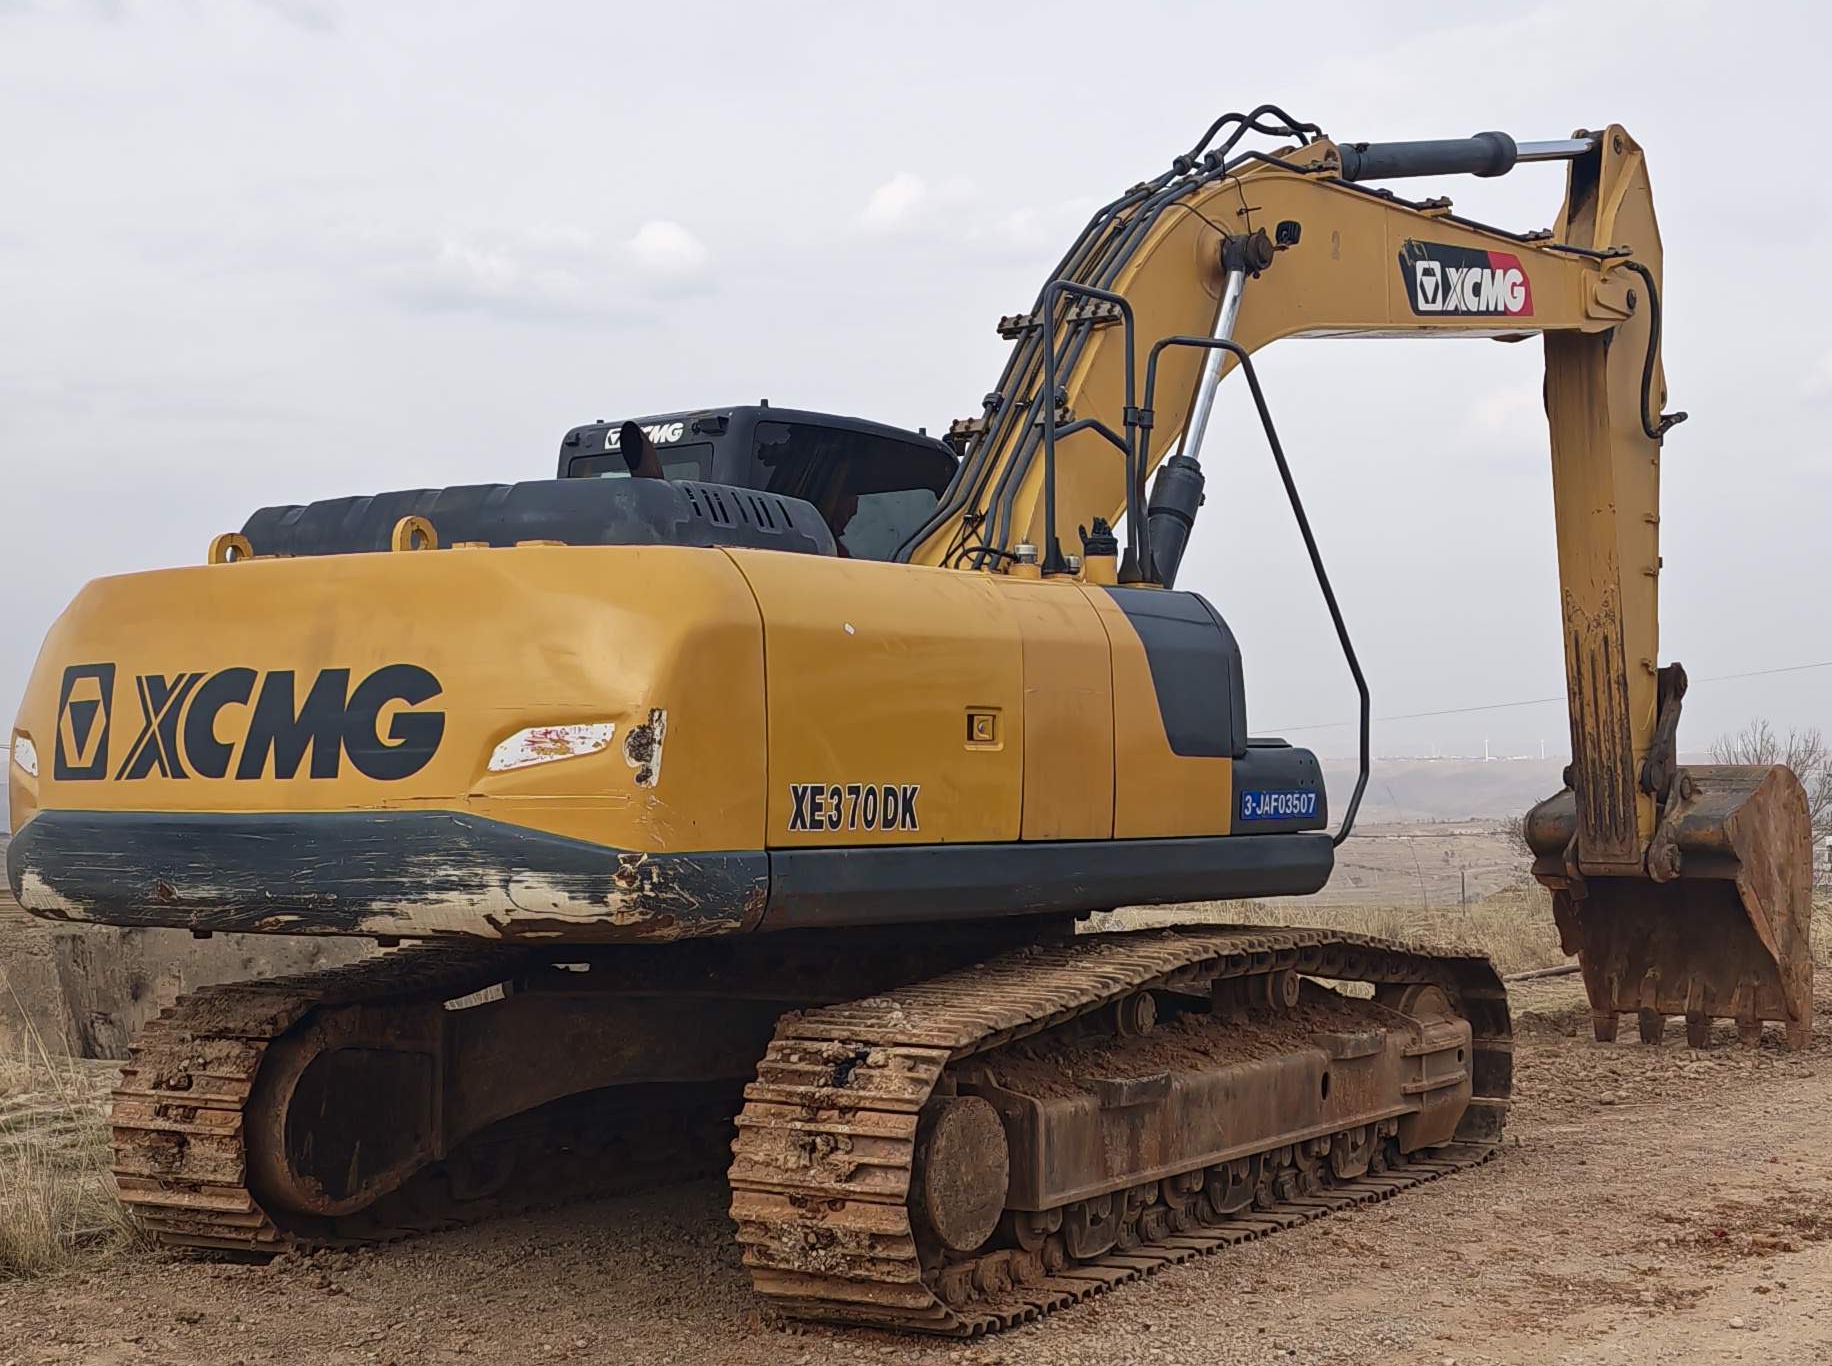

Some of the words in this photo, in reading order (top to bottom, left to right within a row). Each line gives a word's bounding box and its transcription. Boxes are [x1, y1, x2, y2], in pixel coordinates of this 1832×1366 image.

[1442, 267, 1526, 312] XCMG
[639, 422, 684, 444] MG
[115, 662, 446, 782] XCMG
[789, 783, 921, 831] XE370DK
[1243, 792, 1317, 816] 3-JAF03507
